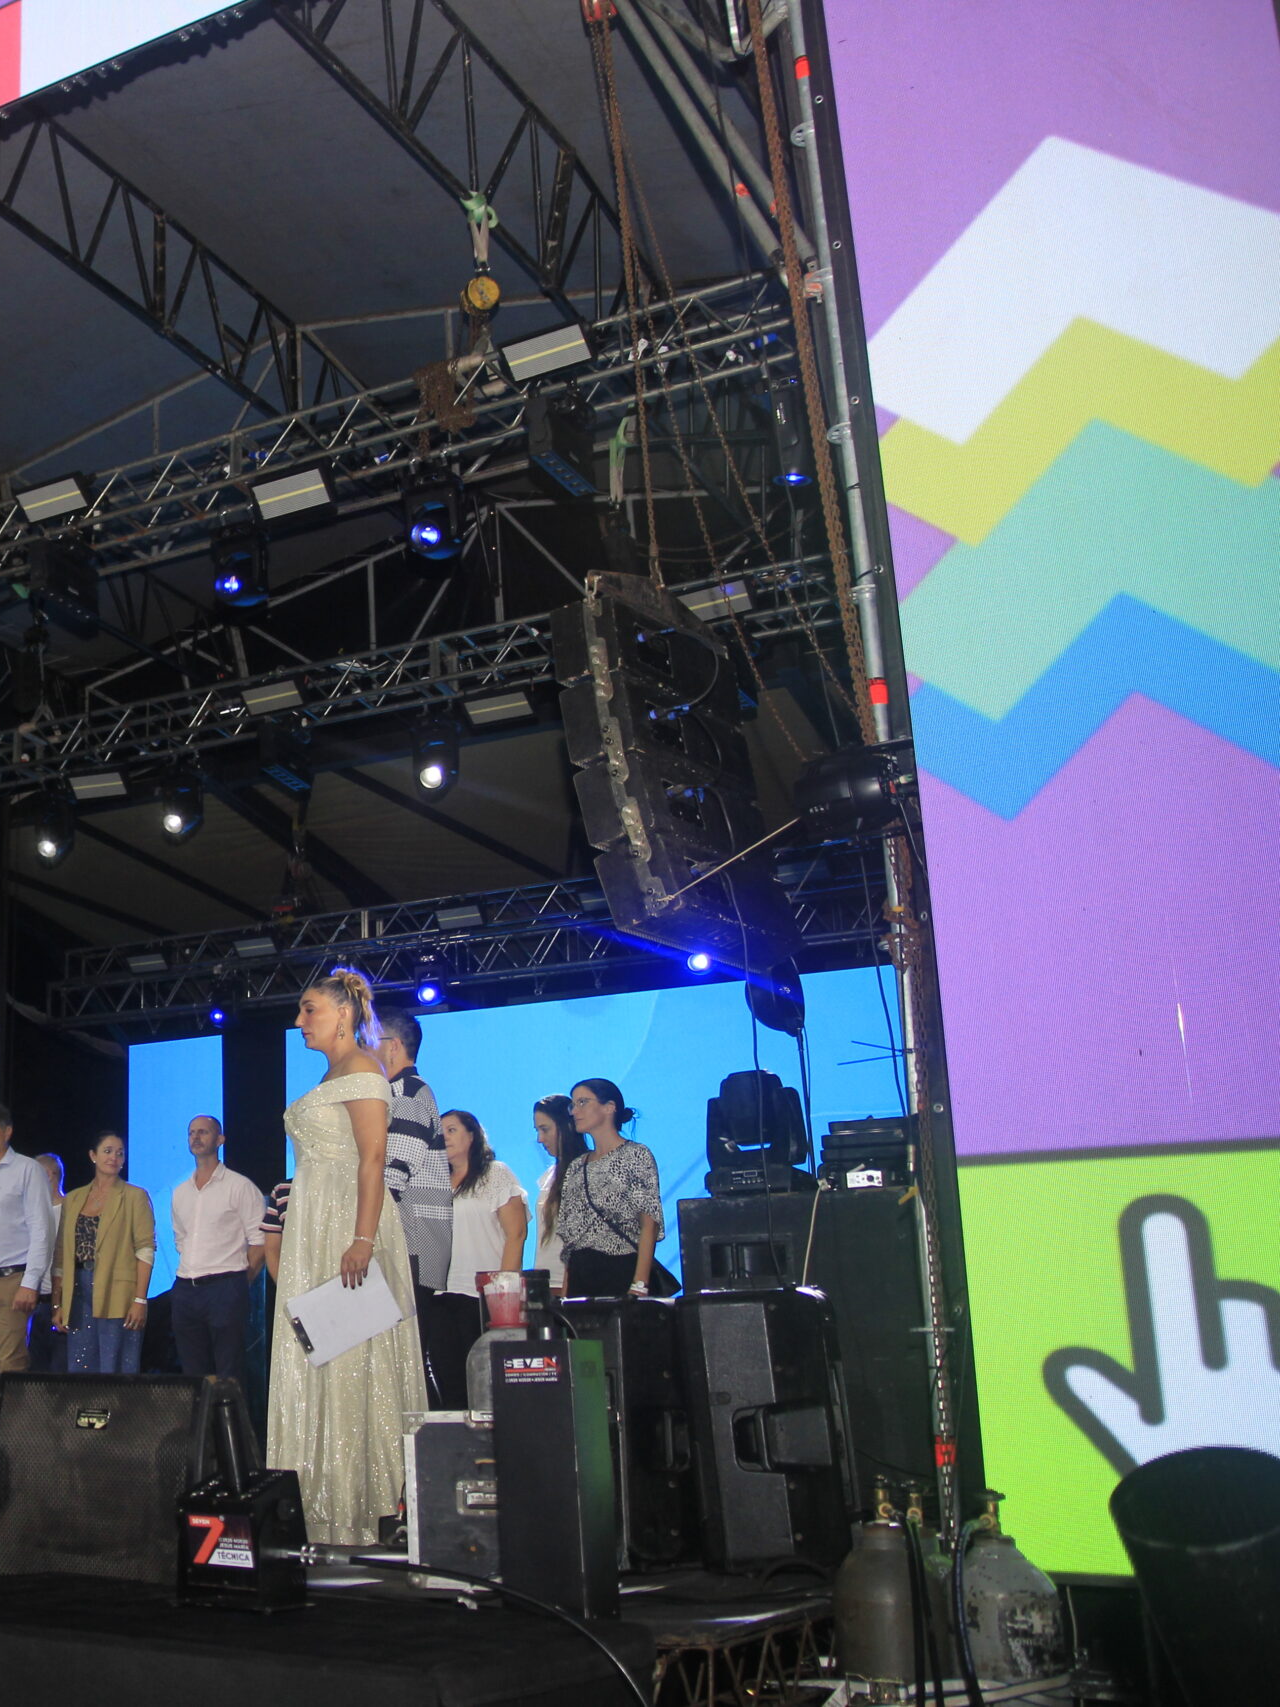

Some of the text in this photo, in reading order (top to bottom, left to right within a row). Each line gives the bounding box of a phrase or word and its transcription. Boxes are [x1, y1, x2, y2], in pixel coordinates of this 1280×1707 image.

[504, 1356, 557, 1369] SEVEN
[189, 1514, 224, 1564] 7
[217, 1551, 250, 1562] TÉCNICA
